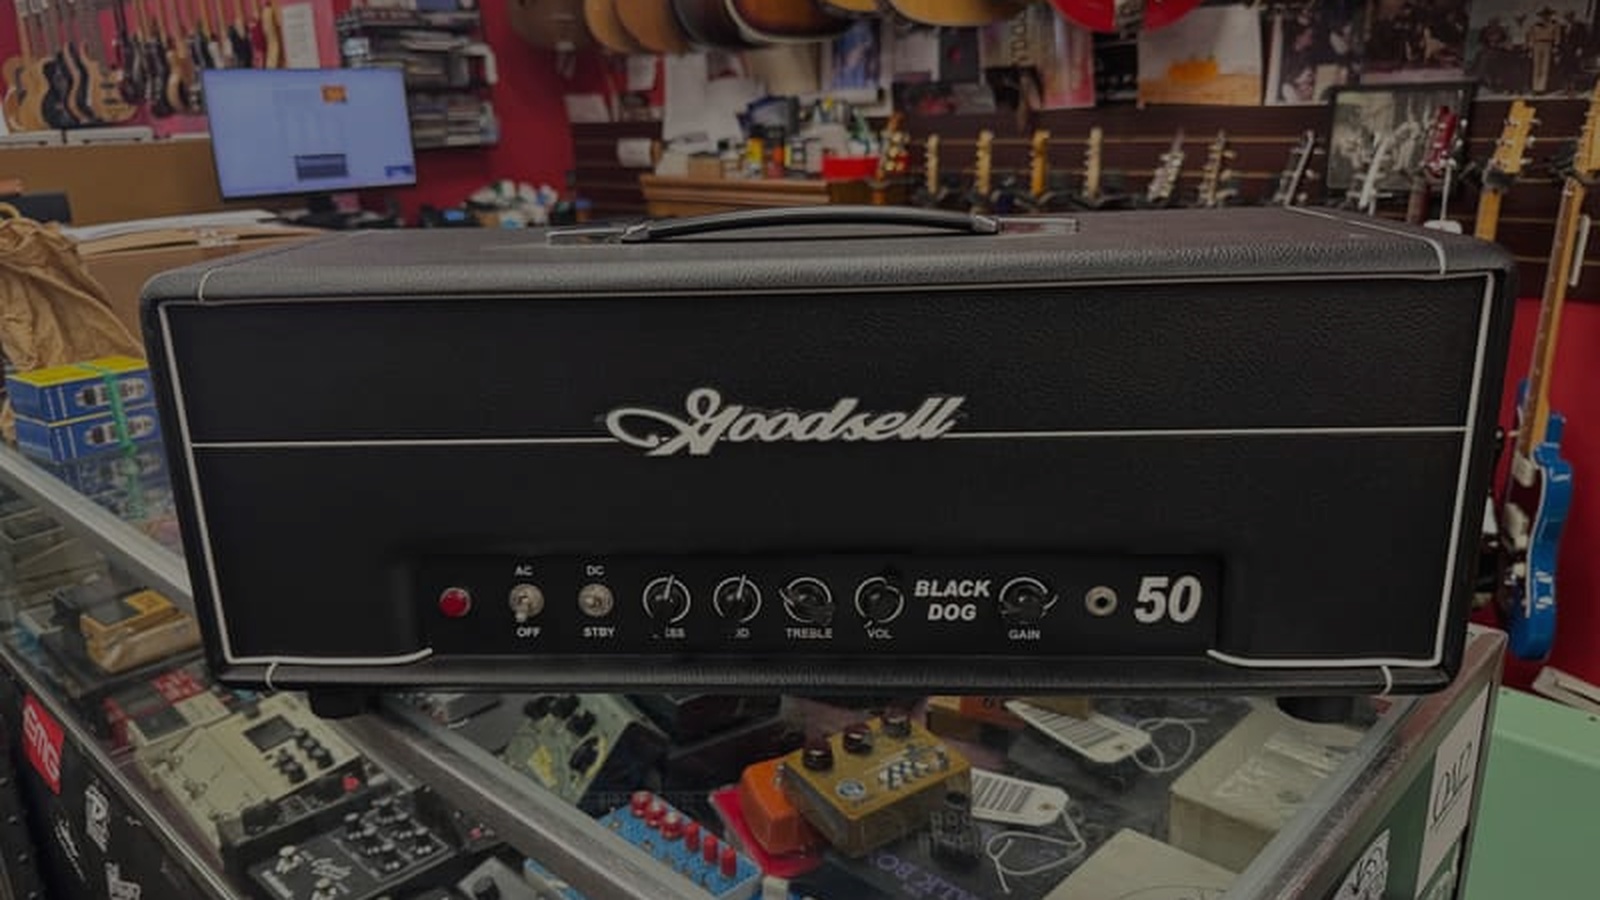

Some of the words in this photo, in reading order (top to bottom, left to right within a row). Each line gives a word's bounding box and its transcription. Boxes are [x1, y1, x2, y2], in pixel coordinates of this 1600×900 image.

[605, 387, 966, 456] Goodsell
[514, 564, 534, 577] AC
[585, 564, 605, 577] DC
[914, 579, 992, 599] BLACK
[1134, 574, 1202, 624] 50
[927, 603, 977, 622] DOG
[516, 626, 541, 638] OFF
[582, 626, 616, 639] STBY
[785, 627, 834, 640] TREBLE
[866, 627, 893, 640] VOL
[1008, 628, 1041, 641] GAIN
